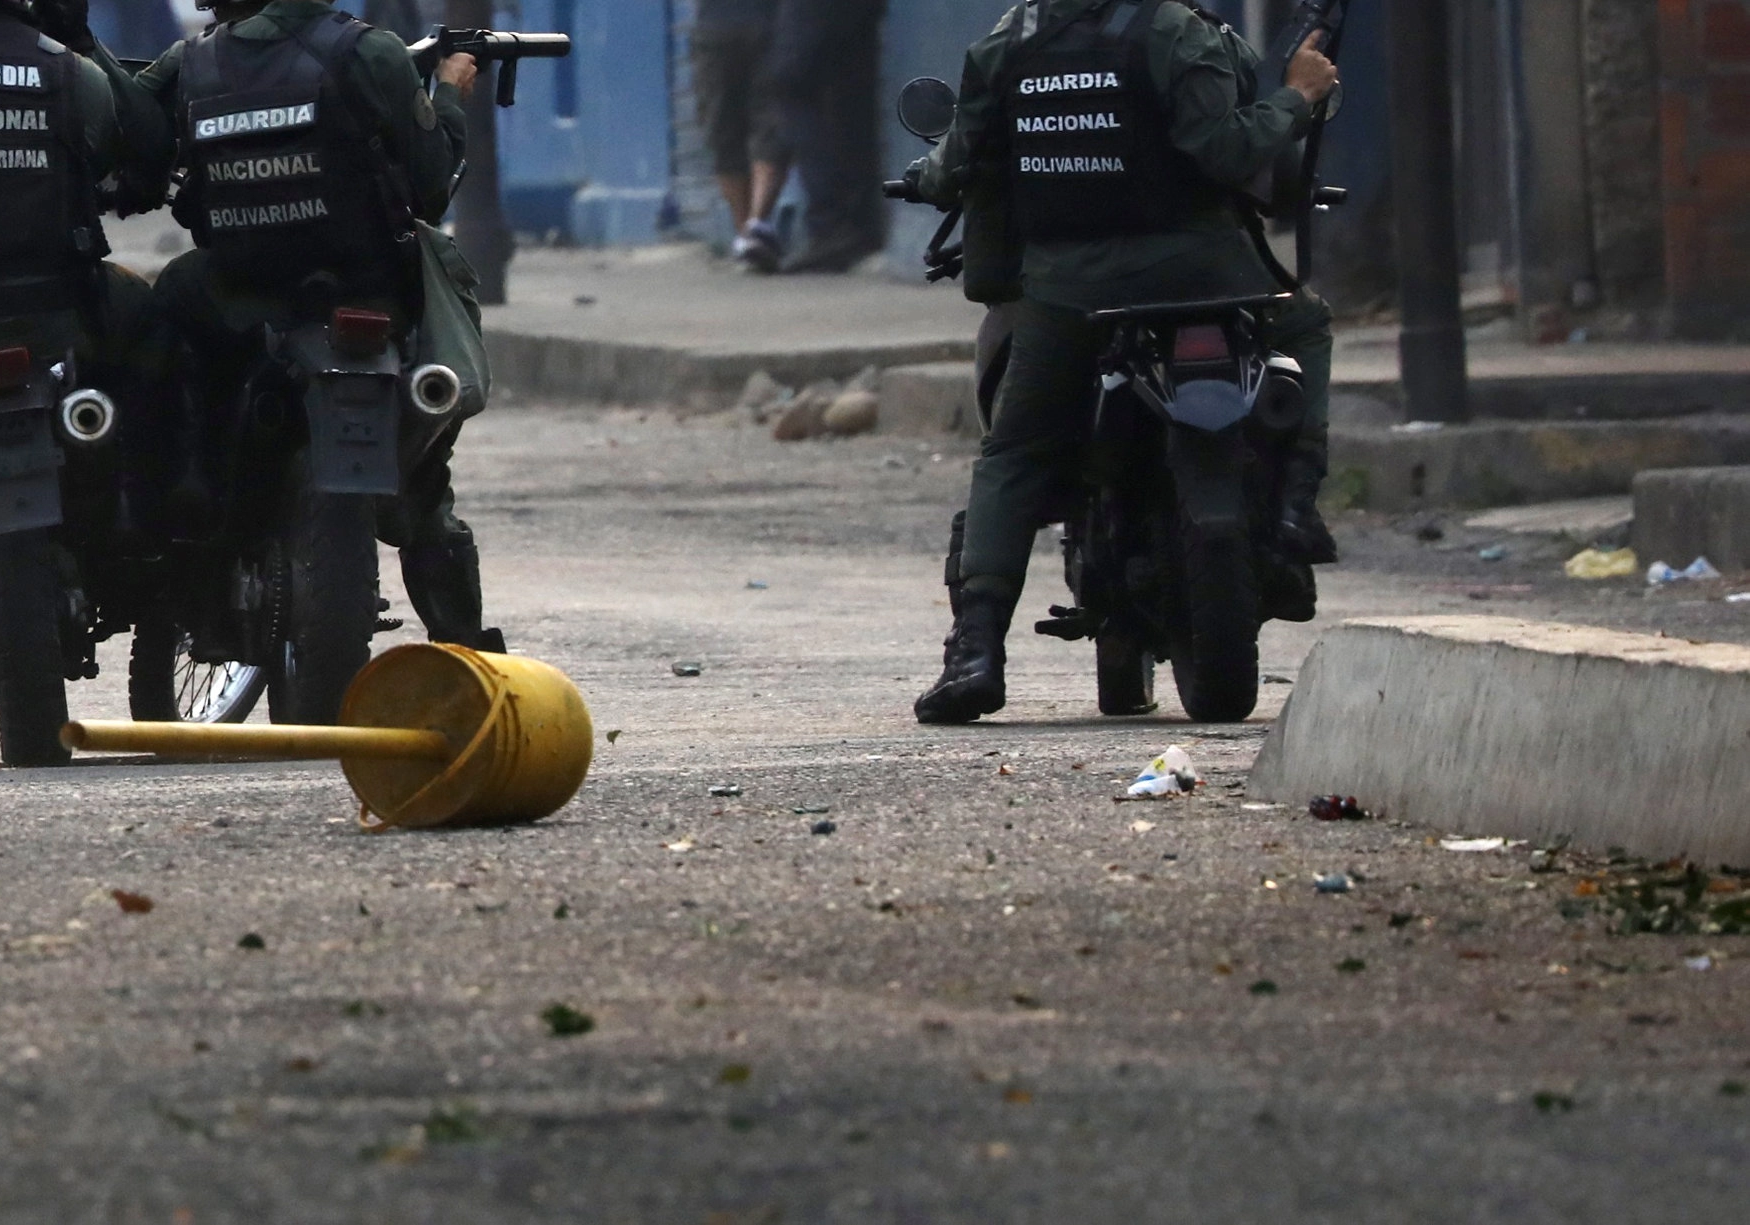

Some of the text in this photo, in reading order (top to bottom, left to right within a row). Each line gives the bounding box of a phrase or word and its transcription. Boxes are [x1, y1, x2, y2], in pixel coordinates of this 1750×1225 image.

[1019, 72, 1119, 95] GUARDIA
[199, 105, 312, 136] GUARDIA
[1016, 112, 1121, 132] NACIONAL
[207, 154, 321, 181] NACIONAL
[1020, 156, 1124, 172] BOLIVARIANA
[210, 198, 328, 227] BOLIVARIANA
